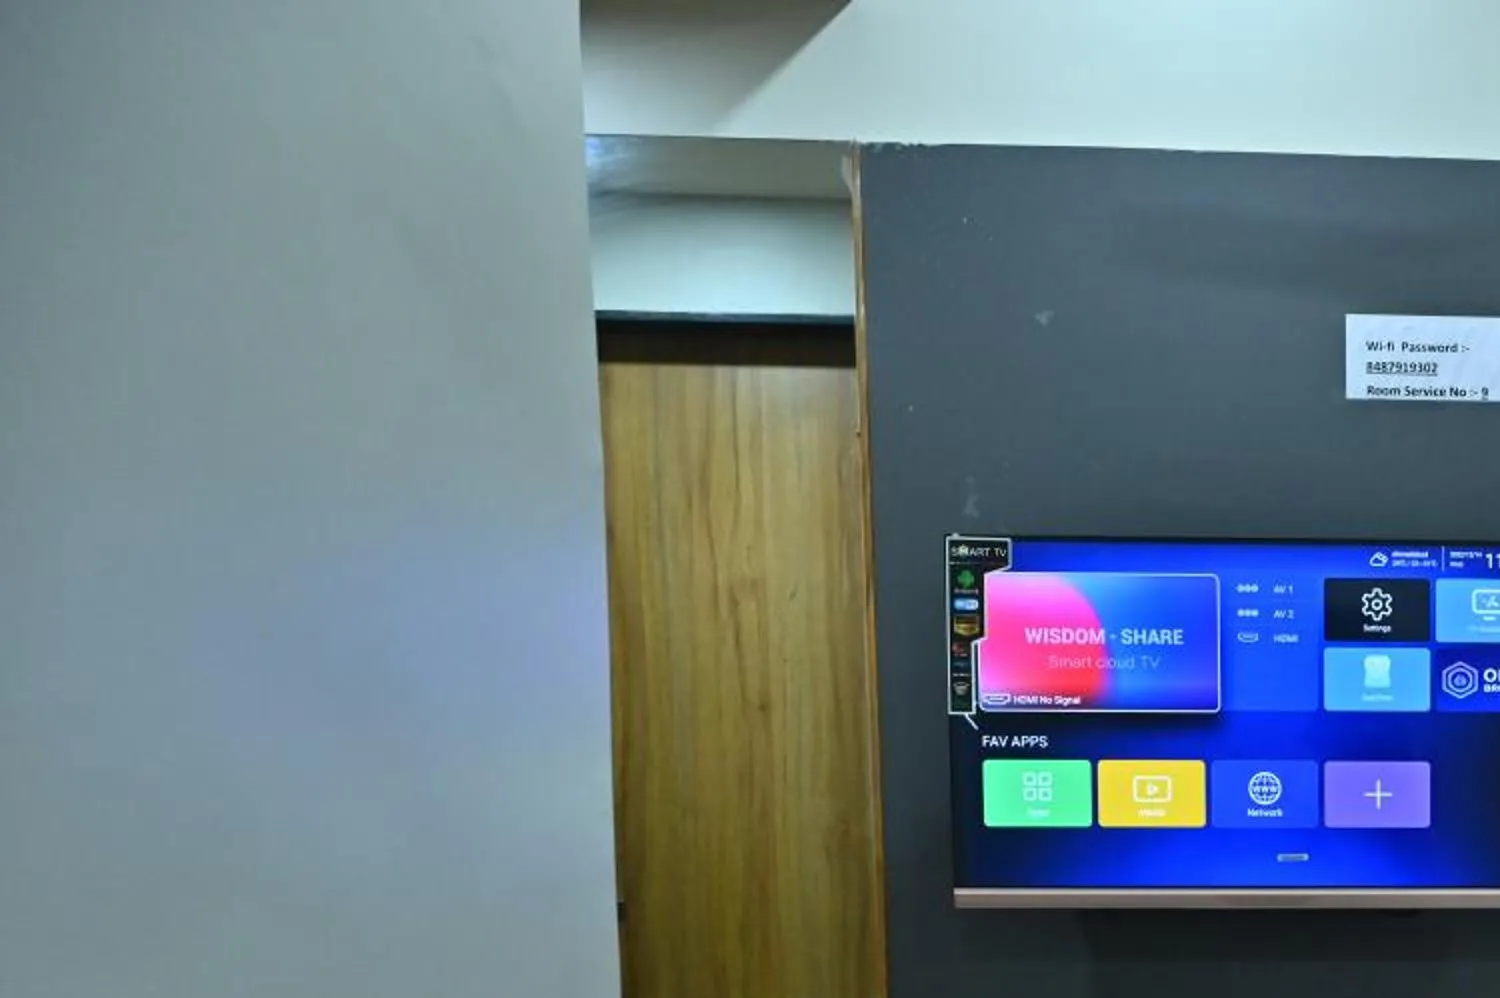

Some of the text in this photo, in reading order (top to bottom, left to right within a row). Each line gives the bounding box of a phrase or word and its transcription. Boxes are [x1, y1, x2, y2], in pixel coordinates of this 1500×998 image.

[1401, 342, 1458, 353] Password
[1366, 361, 1438, 374] 8487919302
[1367, 386, 1400, 396] Room
[1404, 386, 1445, 397] Service
[1449, 388, 1467, 397] No
[1363, 624, 1391, 633] Settings
[1025, 628, 1105, 645] WISDOM
[1120, 629, 1184, 645] SHARE
[1048, 656, 1160, 669] Smart cloud TV
[1013, 695, 1038, 705] HDMI
[1054, 695, 1081, 707] Signal
[982, 736, 1048, 749] FAV APPS
[1247, 808, 1283, 817] Network
